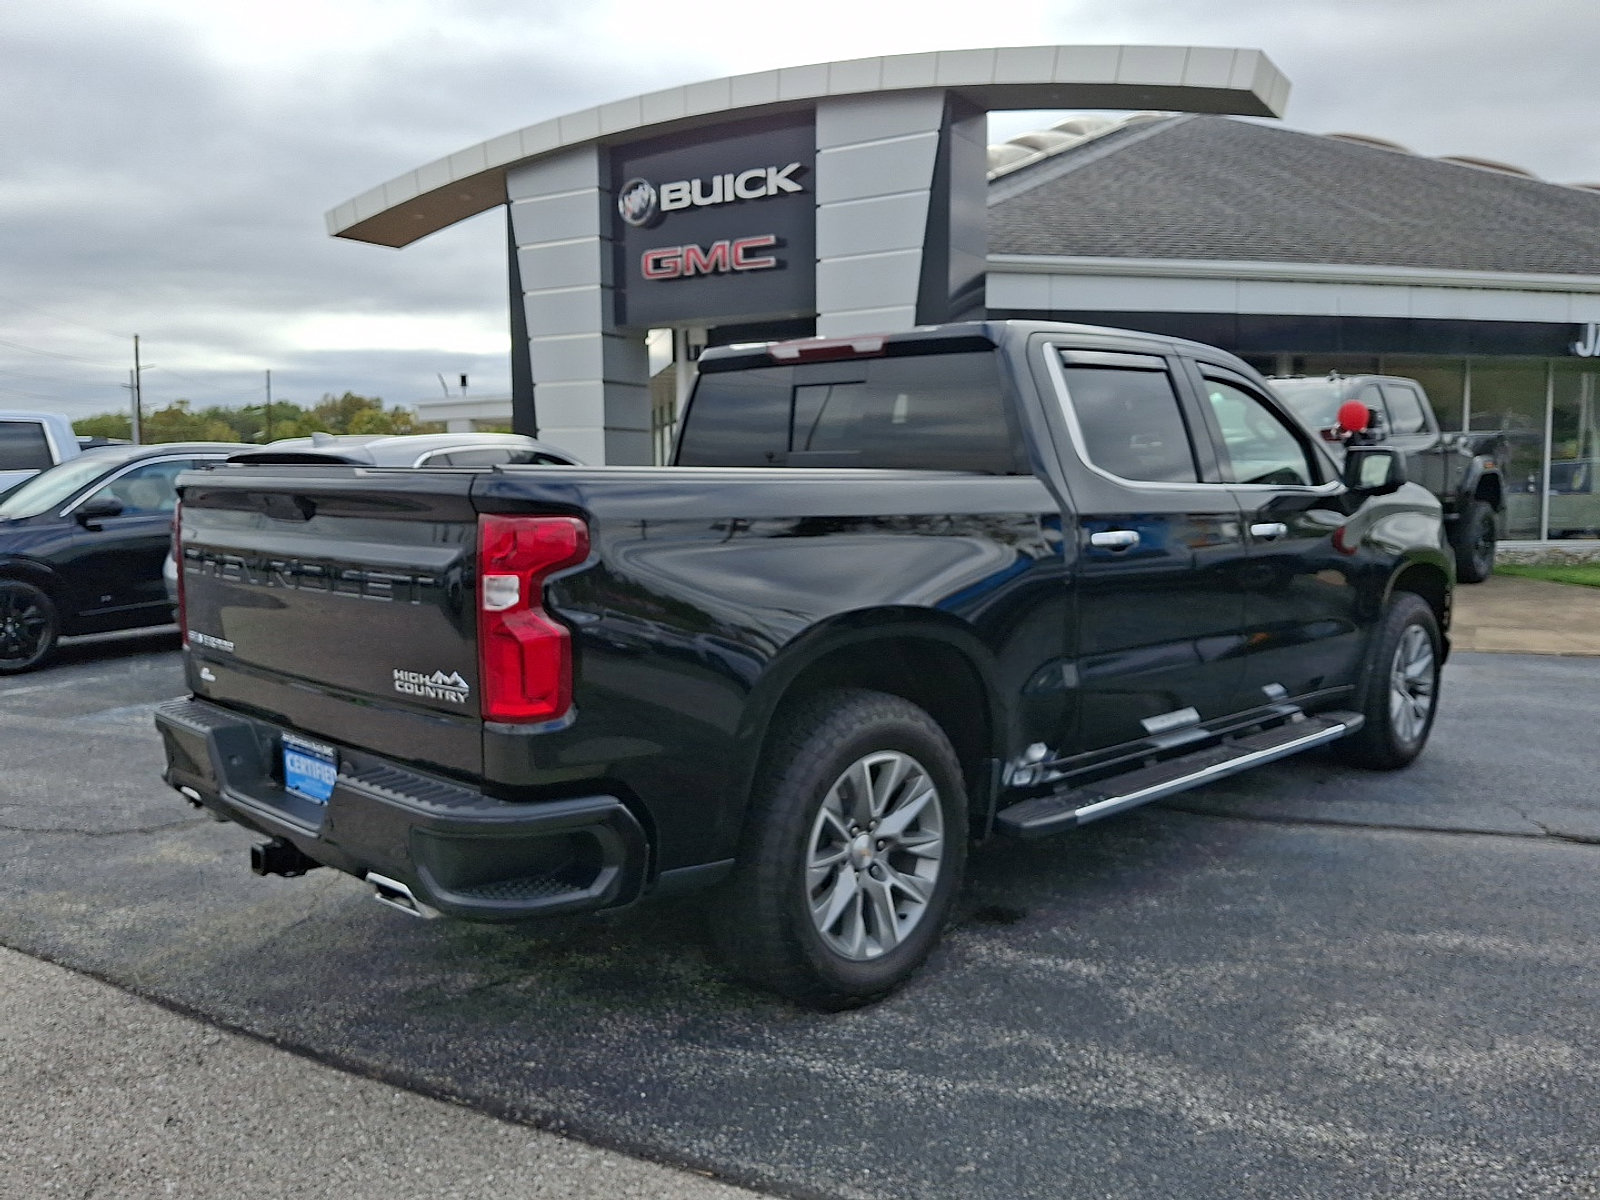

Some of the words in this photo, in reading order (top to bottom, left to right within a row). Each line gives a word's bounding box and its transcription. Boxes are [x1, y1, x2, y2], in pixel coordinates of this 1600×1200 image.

[660, 162, 803, 212] BUICK
[642, 234, 776, 280] GMC
[393, 668, 431, 685] HIGH
[394, 680, 469, 704] COUNTRY
